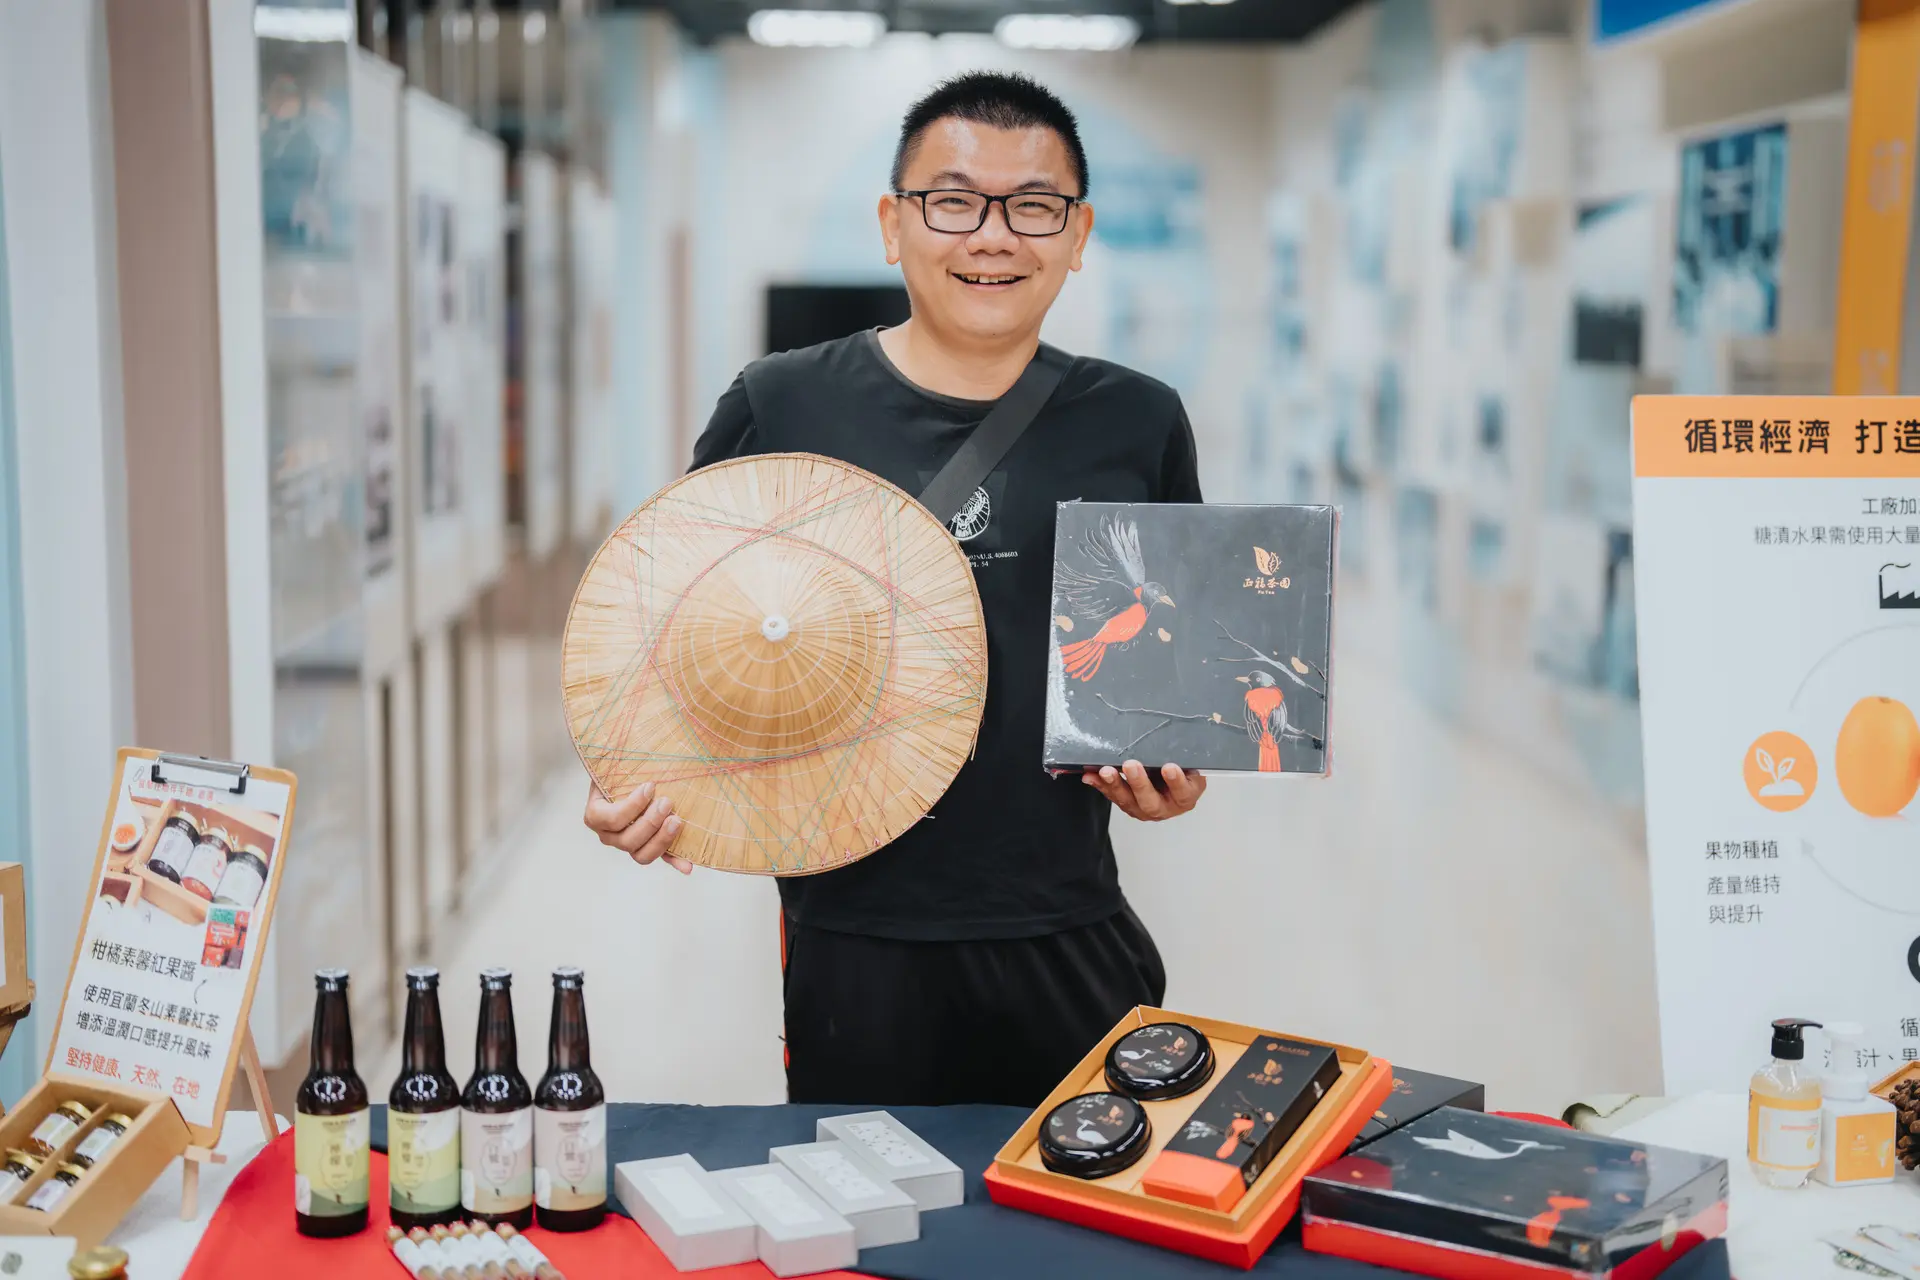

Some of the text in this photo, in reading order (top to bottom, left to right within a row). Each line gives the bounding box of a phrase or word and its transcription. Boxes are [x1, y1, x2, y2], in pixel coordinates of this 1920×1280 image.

[1684, 418, 1920, 454] 循環經濟 打造
[1862, 496, 1920, 516] 工廠加
[1705, 840, 1779, 860] 果物種植
[1707, 874, 1781, 895] 產量維持
[1709, 904, 1763, 924] 與提升
[92, 939, 197, 982] 柑橘素馨紅果醬
[83, 983, 220, 1032] 使用宜蘭冬山素馨紅茶
[172, 1076, 200, 1099] 在地
